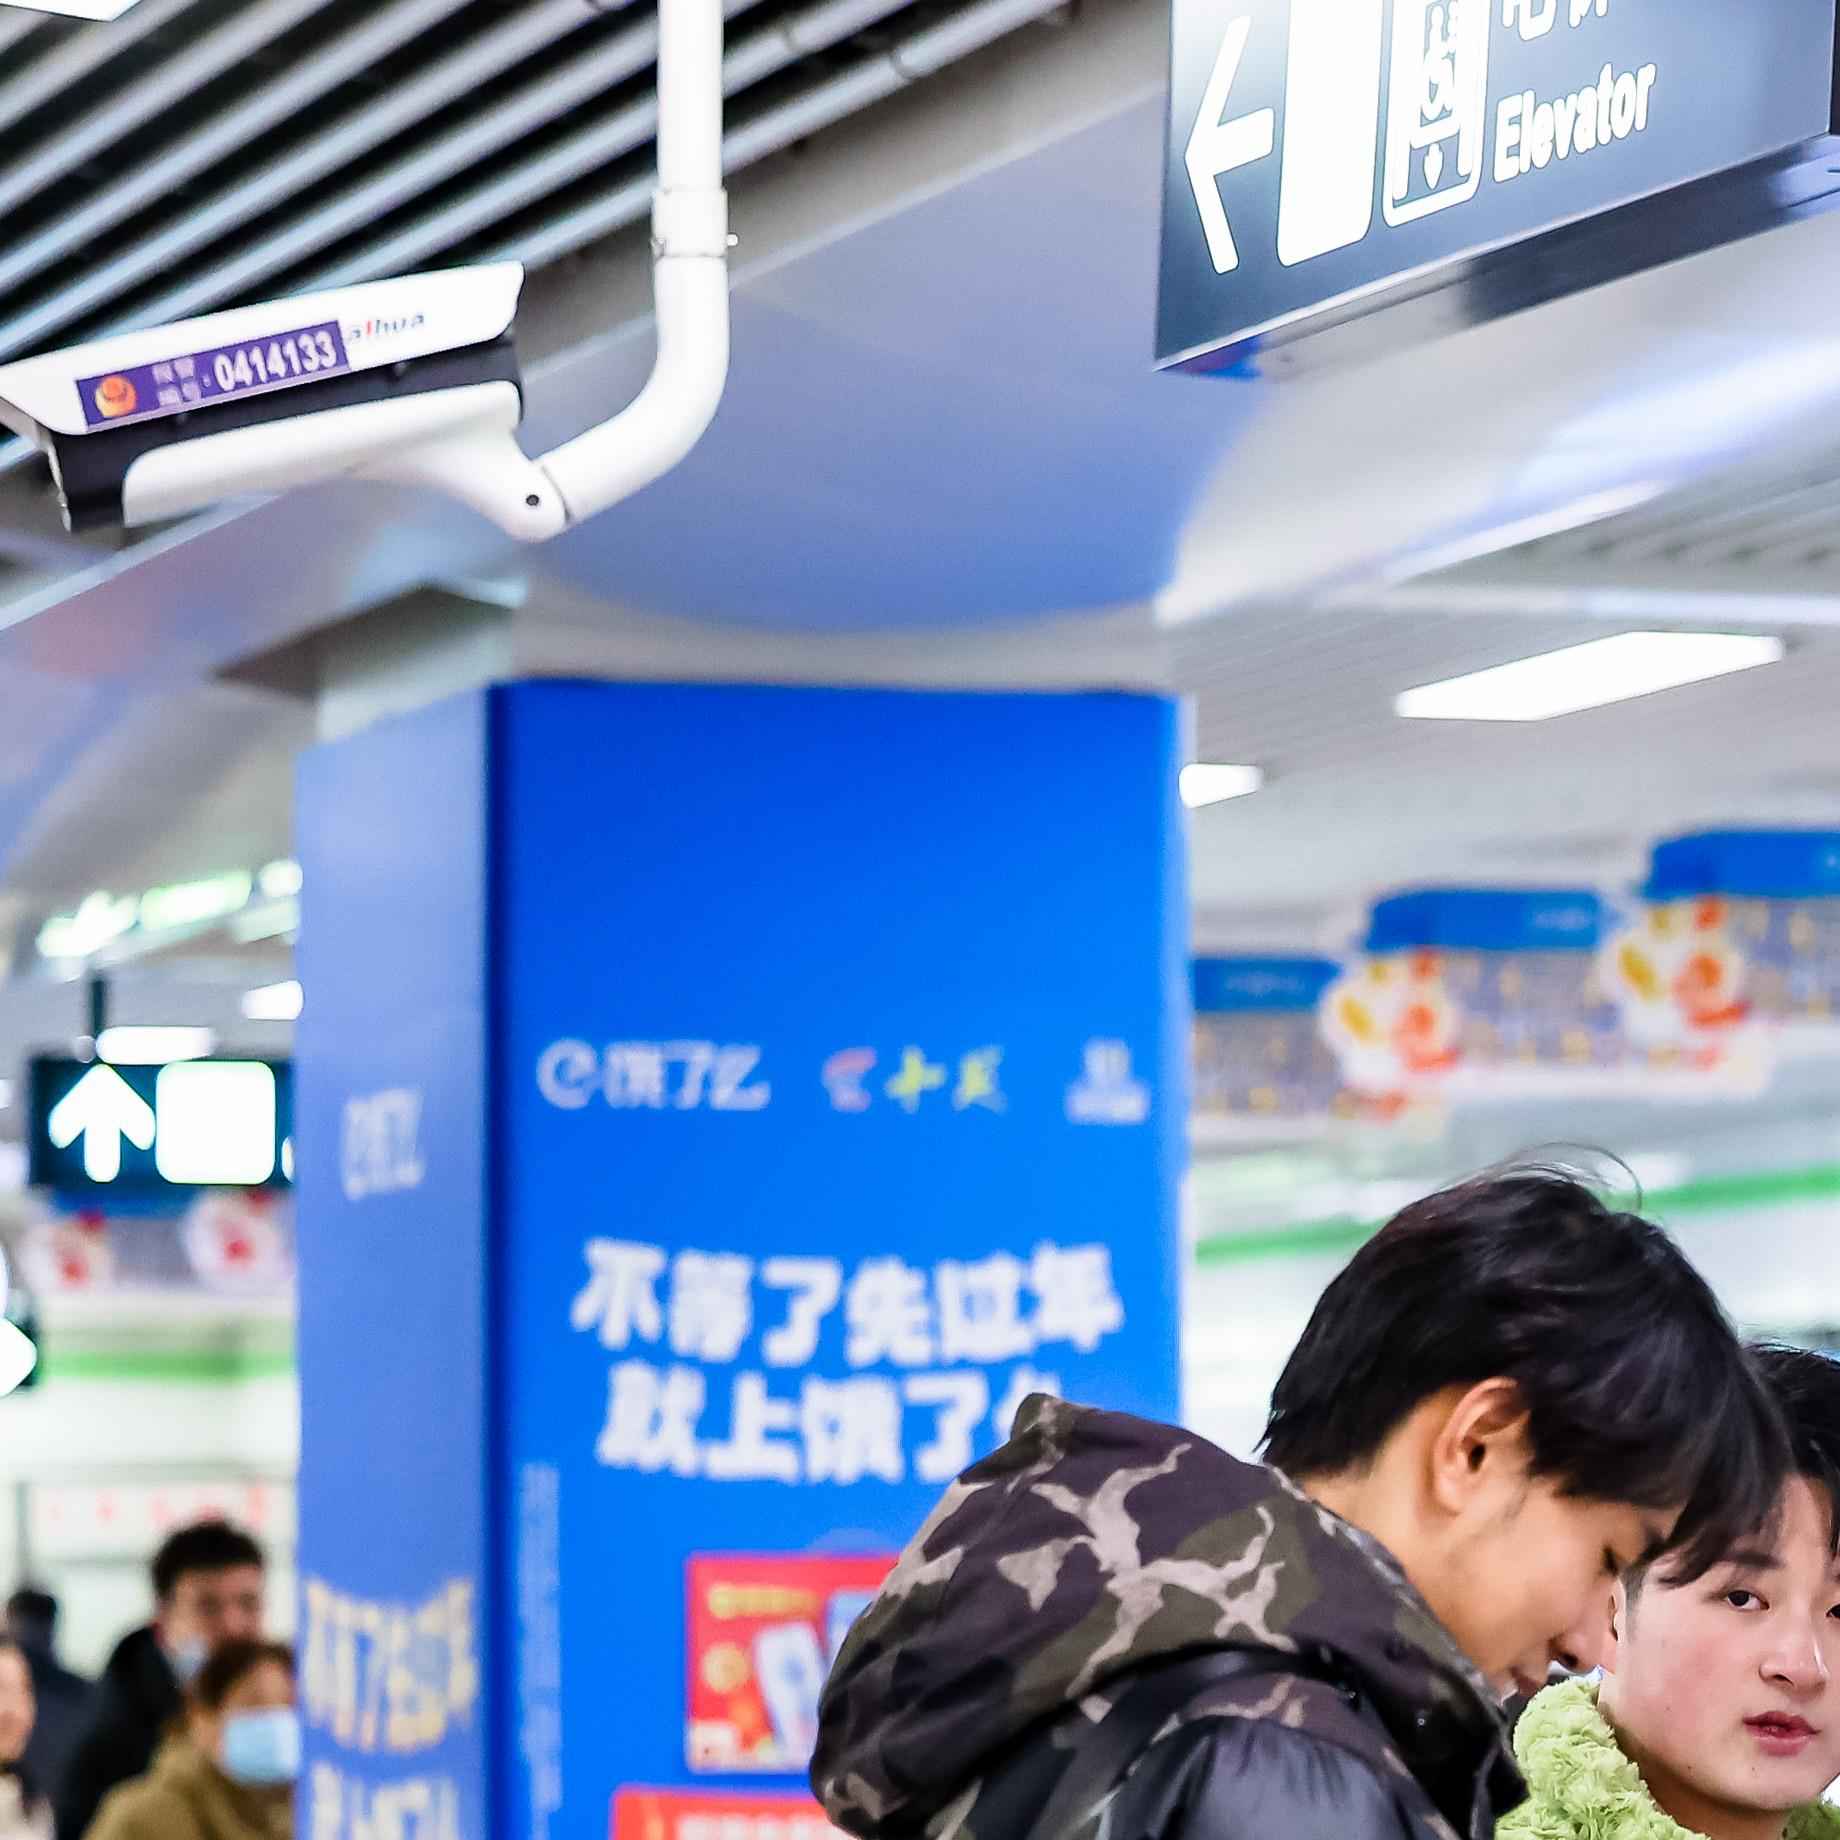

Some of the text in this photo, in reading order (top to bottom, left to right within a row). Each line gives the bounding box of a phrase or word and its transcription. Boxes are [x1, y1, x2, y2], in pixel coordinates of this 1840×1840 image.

[1493, 62, 1657, 183] Elevator
[212, 330, 338, 393] 0414133
[596, 1361, 1064, 1486] 就上饿了
